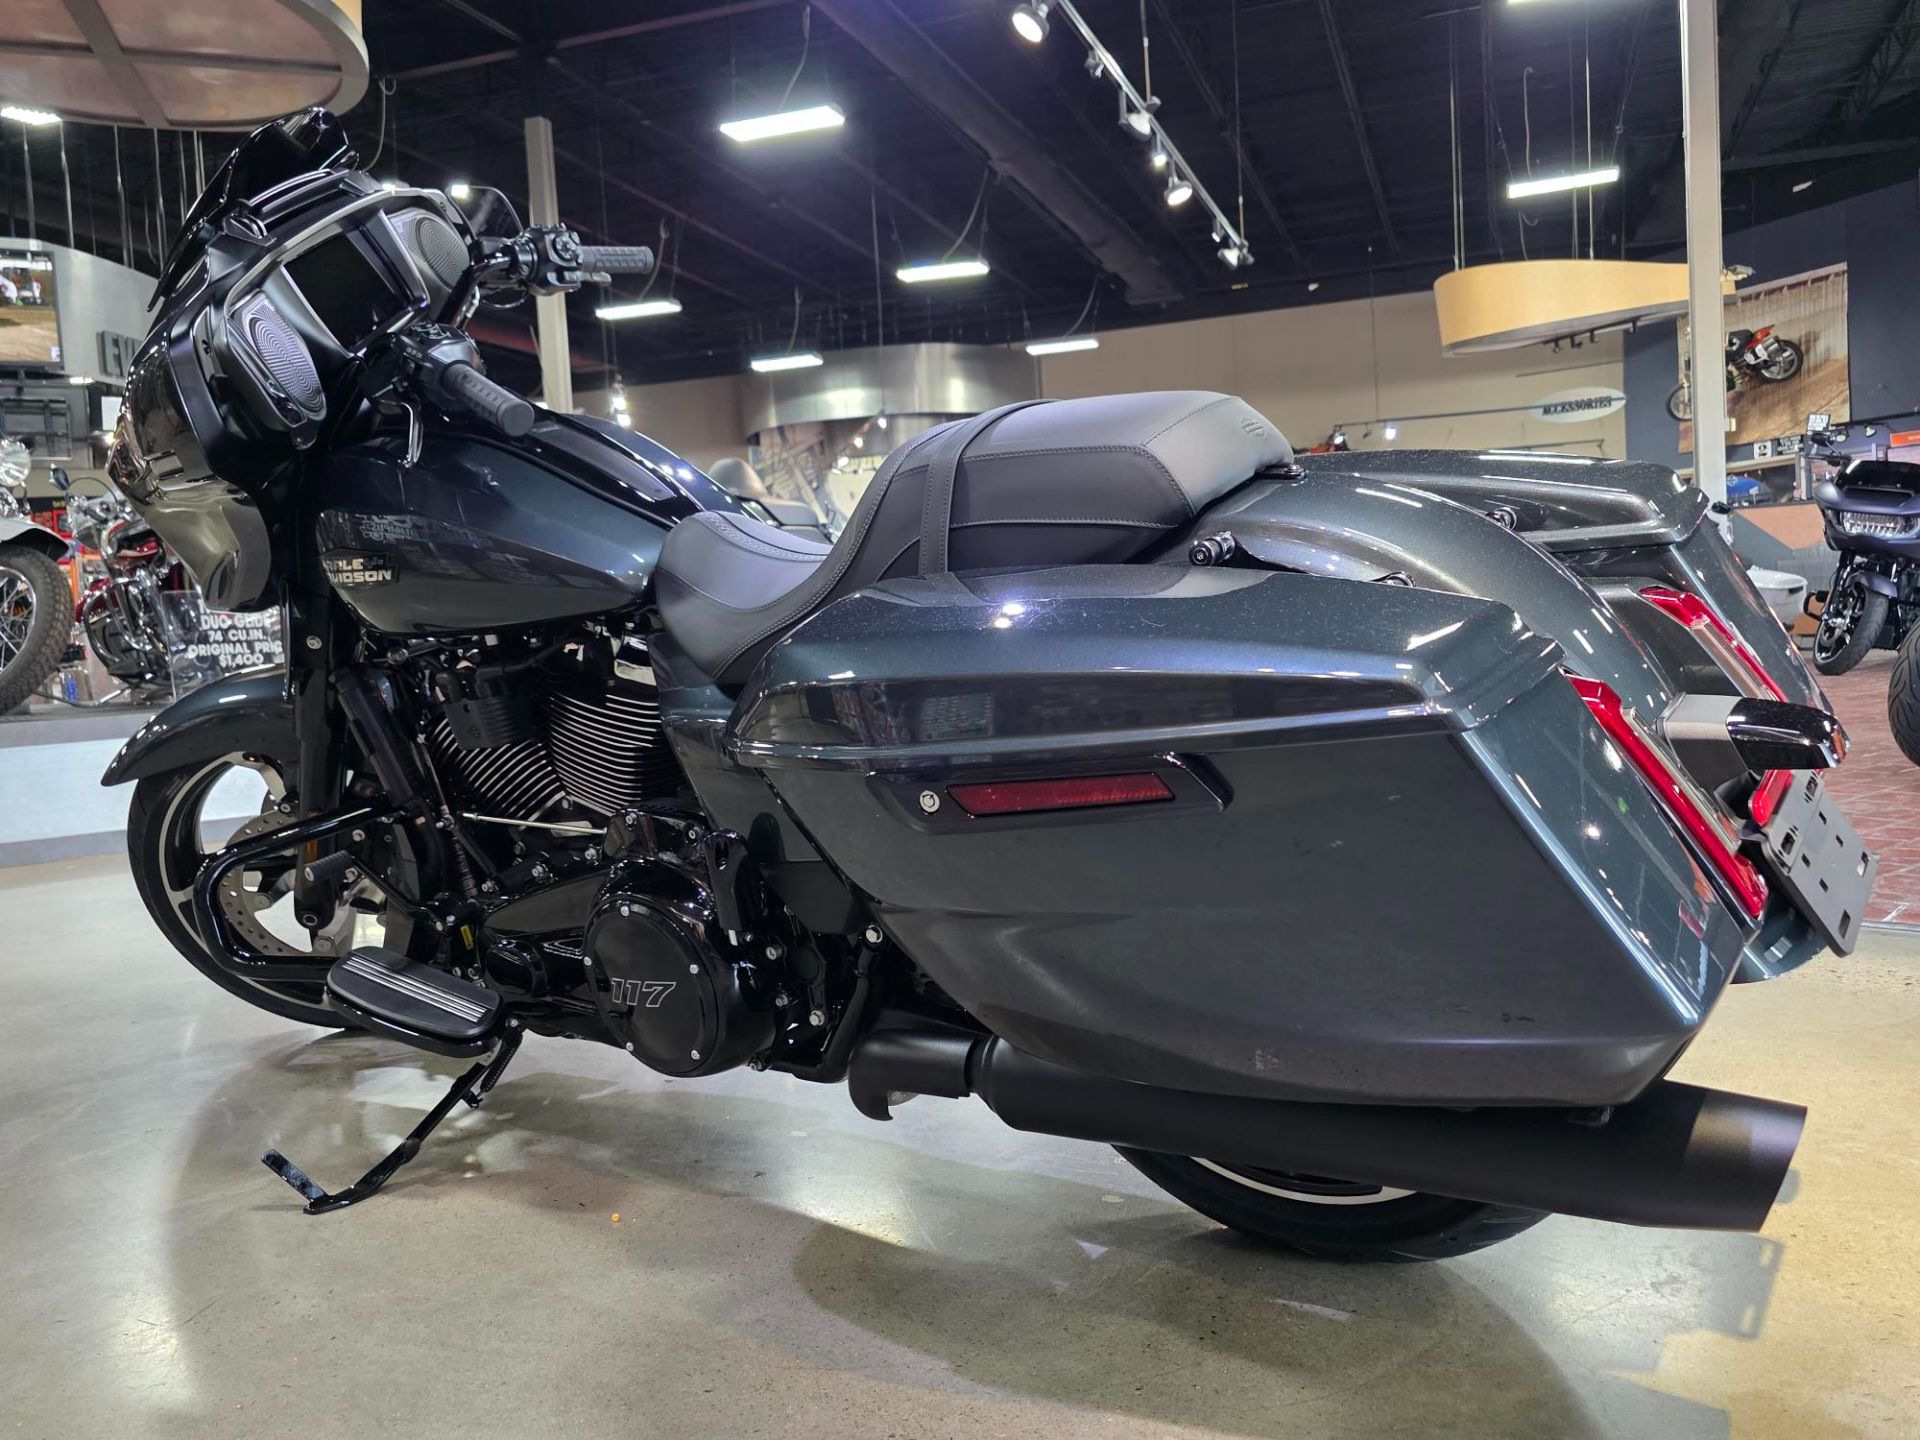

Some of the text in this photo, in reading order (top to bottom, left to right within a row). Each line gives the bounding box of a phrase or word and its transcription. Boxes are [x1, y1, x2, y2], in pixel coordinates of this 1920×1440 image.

[201, 614, 232, 630] DUO
[208, 630, 223, 642] 74
[187, 640, 283, 658] ORIGINAL PRIC
[219, 653, 264, 668] $1,400
[611, 977, 676, 1007] 117
